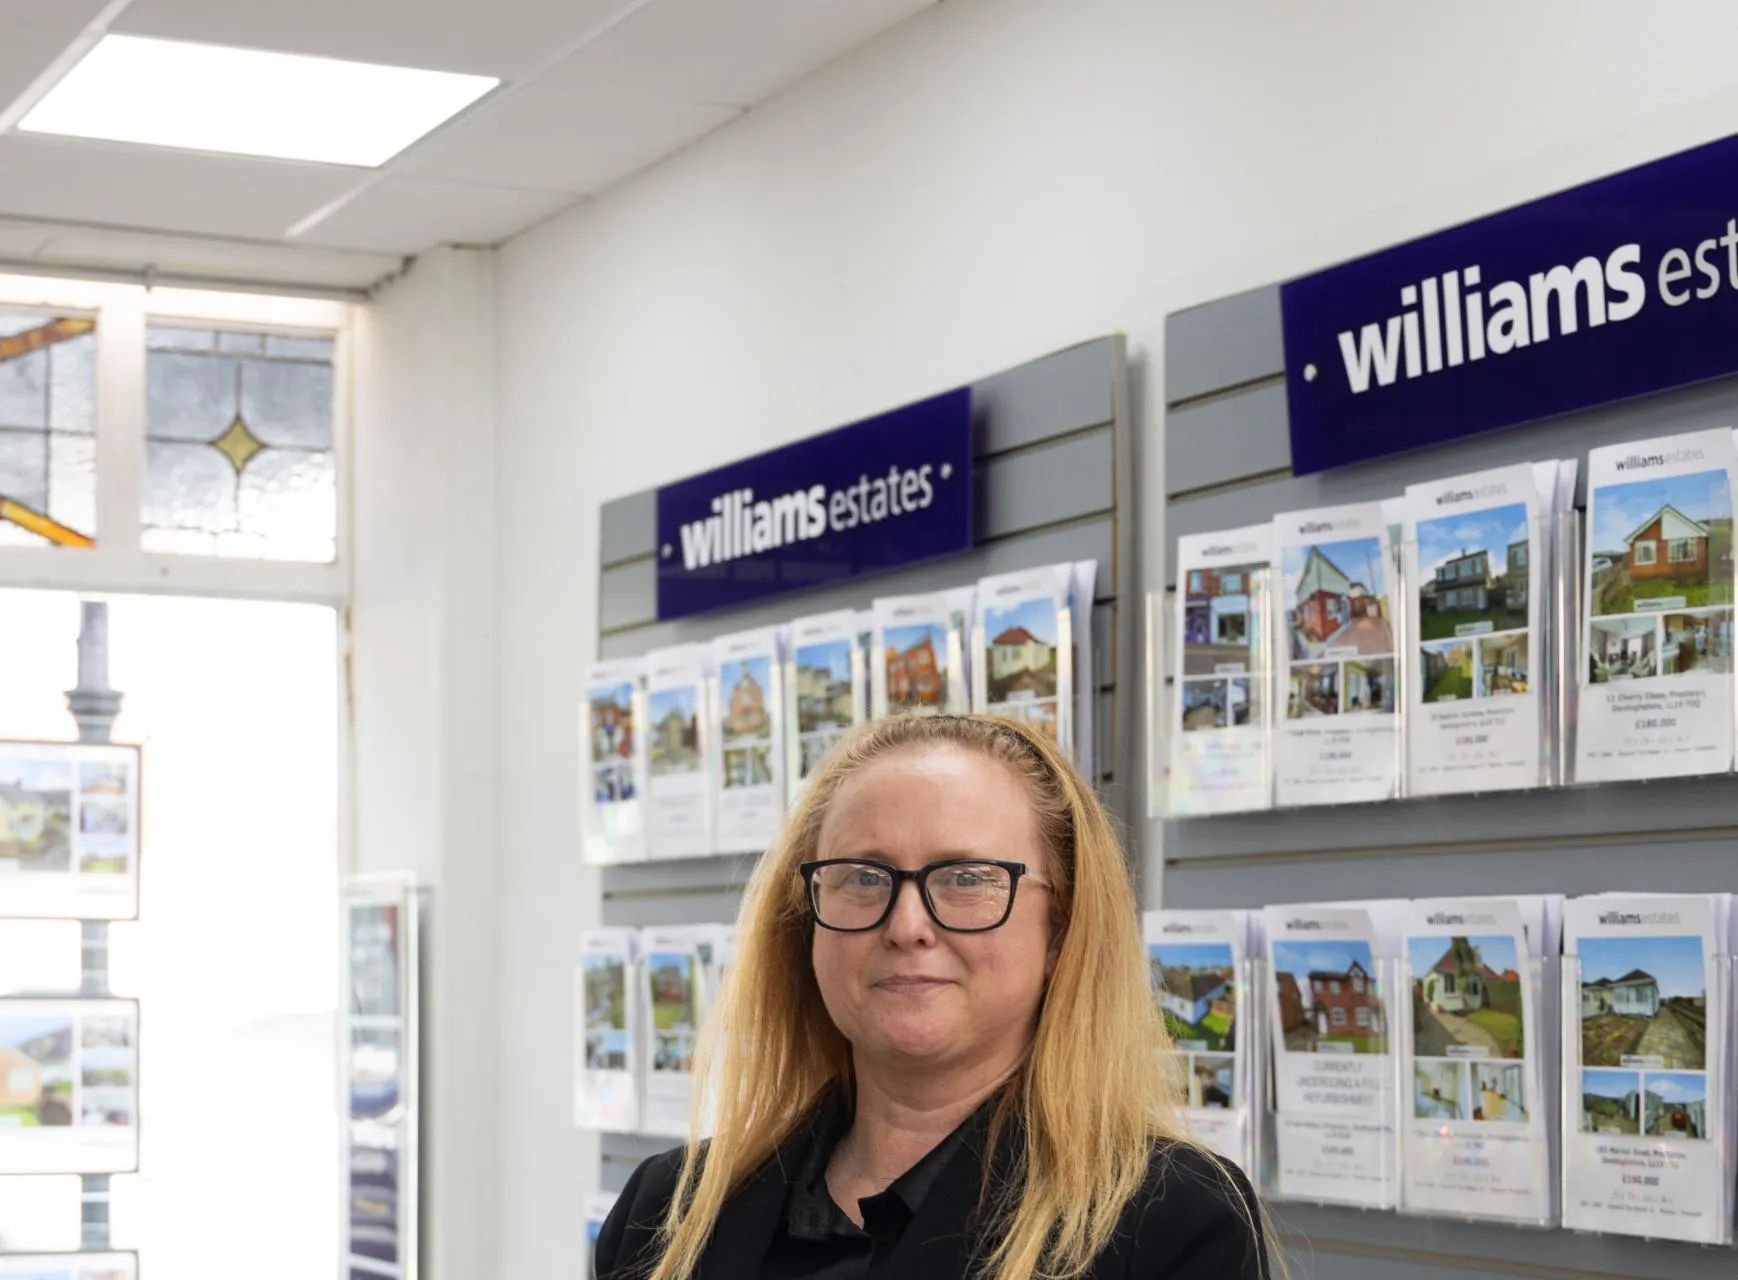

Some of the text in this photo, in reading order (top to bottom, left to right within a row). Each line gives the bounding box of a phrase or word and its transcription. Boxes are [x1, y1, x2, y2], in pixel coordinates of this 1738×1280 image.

[1337, 217, 1738, 394] williams est
[1615, 448, 1705, 472] williams estates
[680, 464, 934, 571] williams estates
[1426, 911, 1464, 925] williams
[1598, 910, 1641, 925] williams
